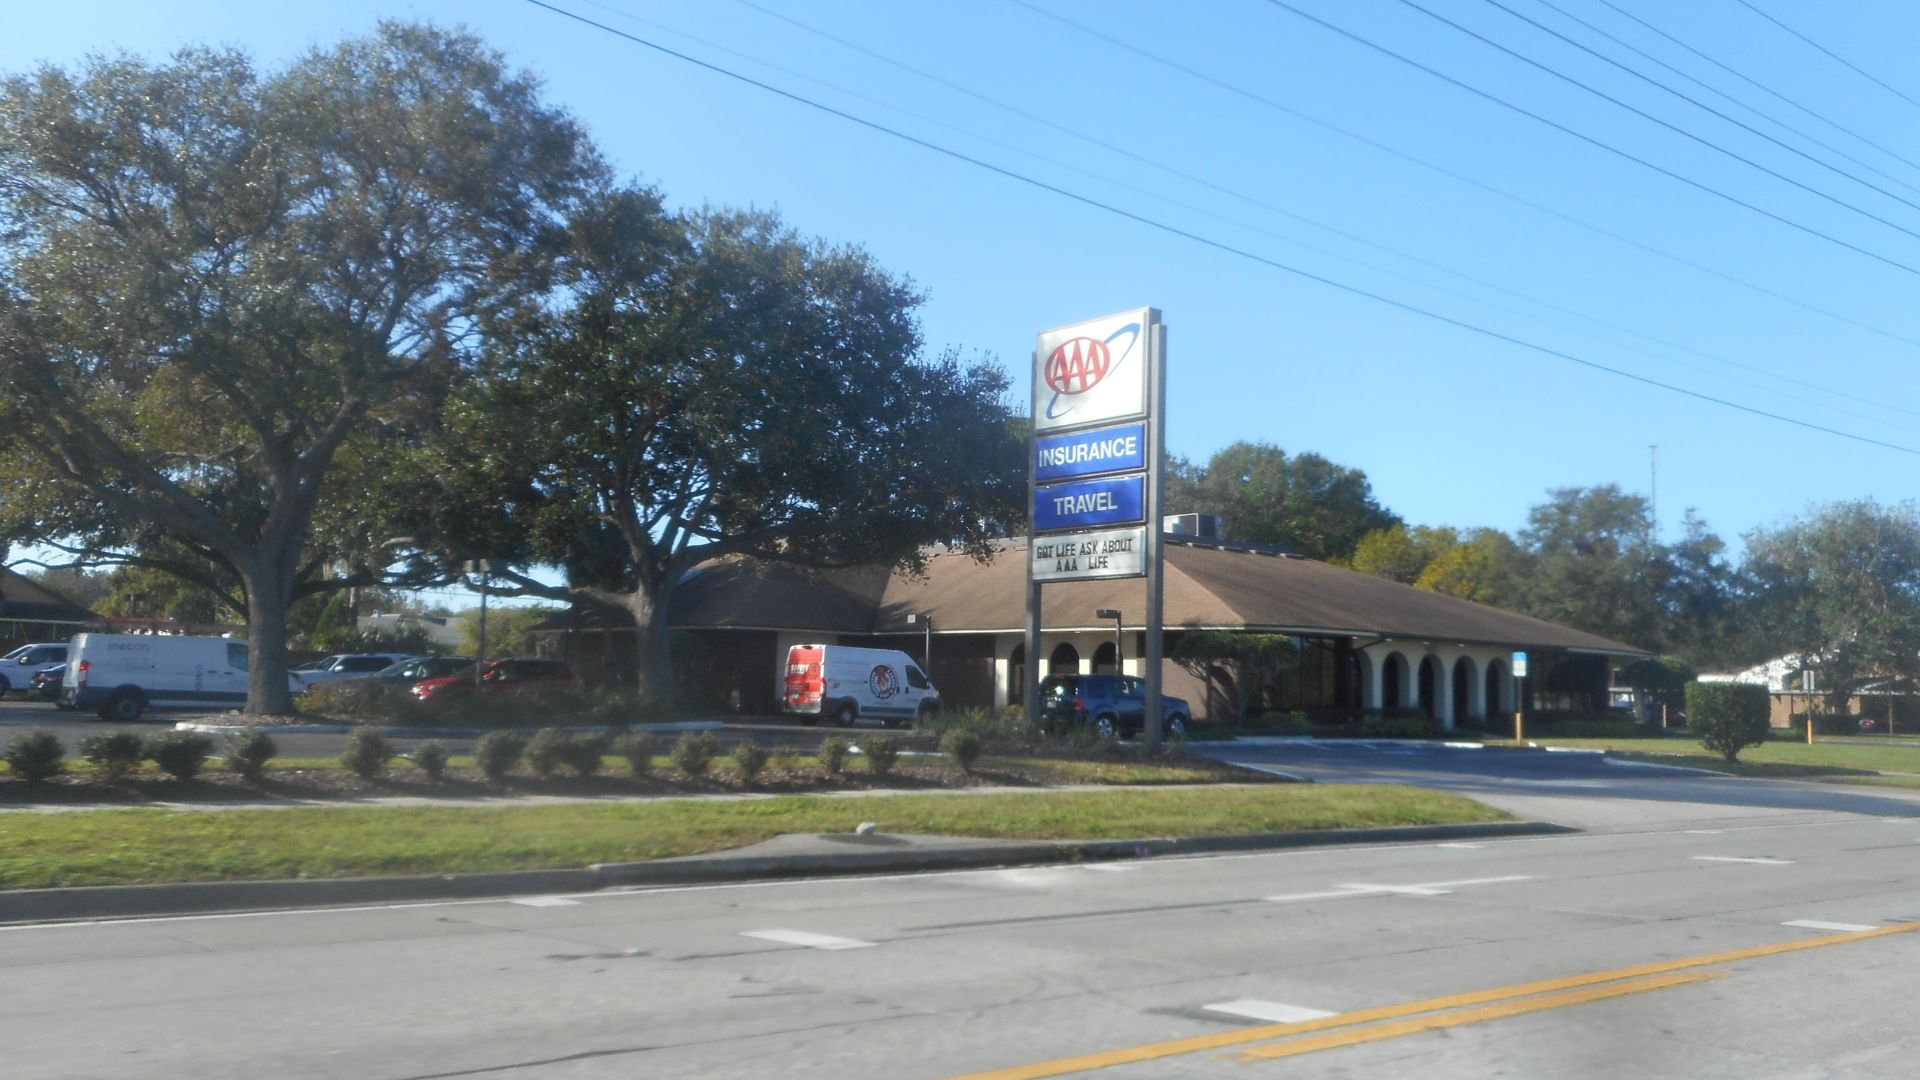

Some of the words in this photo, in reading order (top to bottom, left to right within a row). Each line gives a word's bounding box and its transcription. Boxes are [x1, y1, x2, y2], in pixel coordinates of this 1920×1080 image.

[1046, 338, 1108, 393] AAA
[1039, 436, 1136, 467] INSURANCE
[1053, 492, 1118, 515] TRAVEL
[1056, 544, 1076, 557] LIFE
[1080, 541, 1098, 555] ASK
[1102, 538, 1133, 554] ABOUT
[1056, 559, 1078, 572] AAA
[1088, 556, 1108, 569] LIFE
